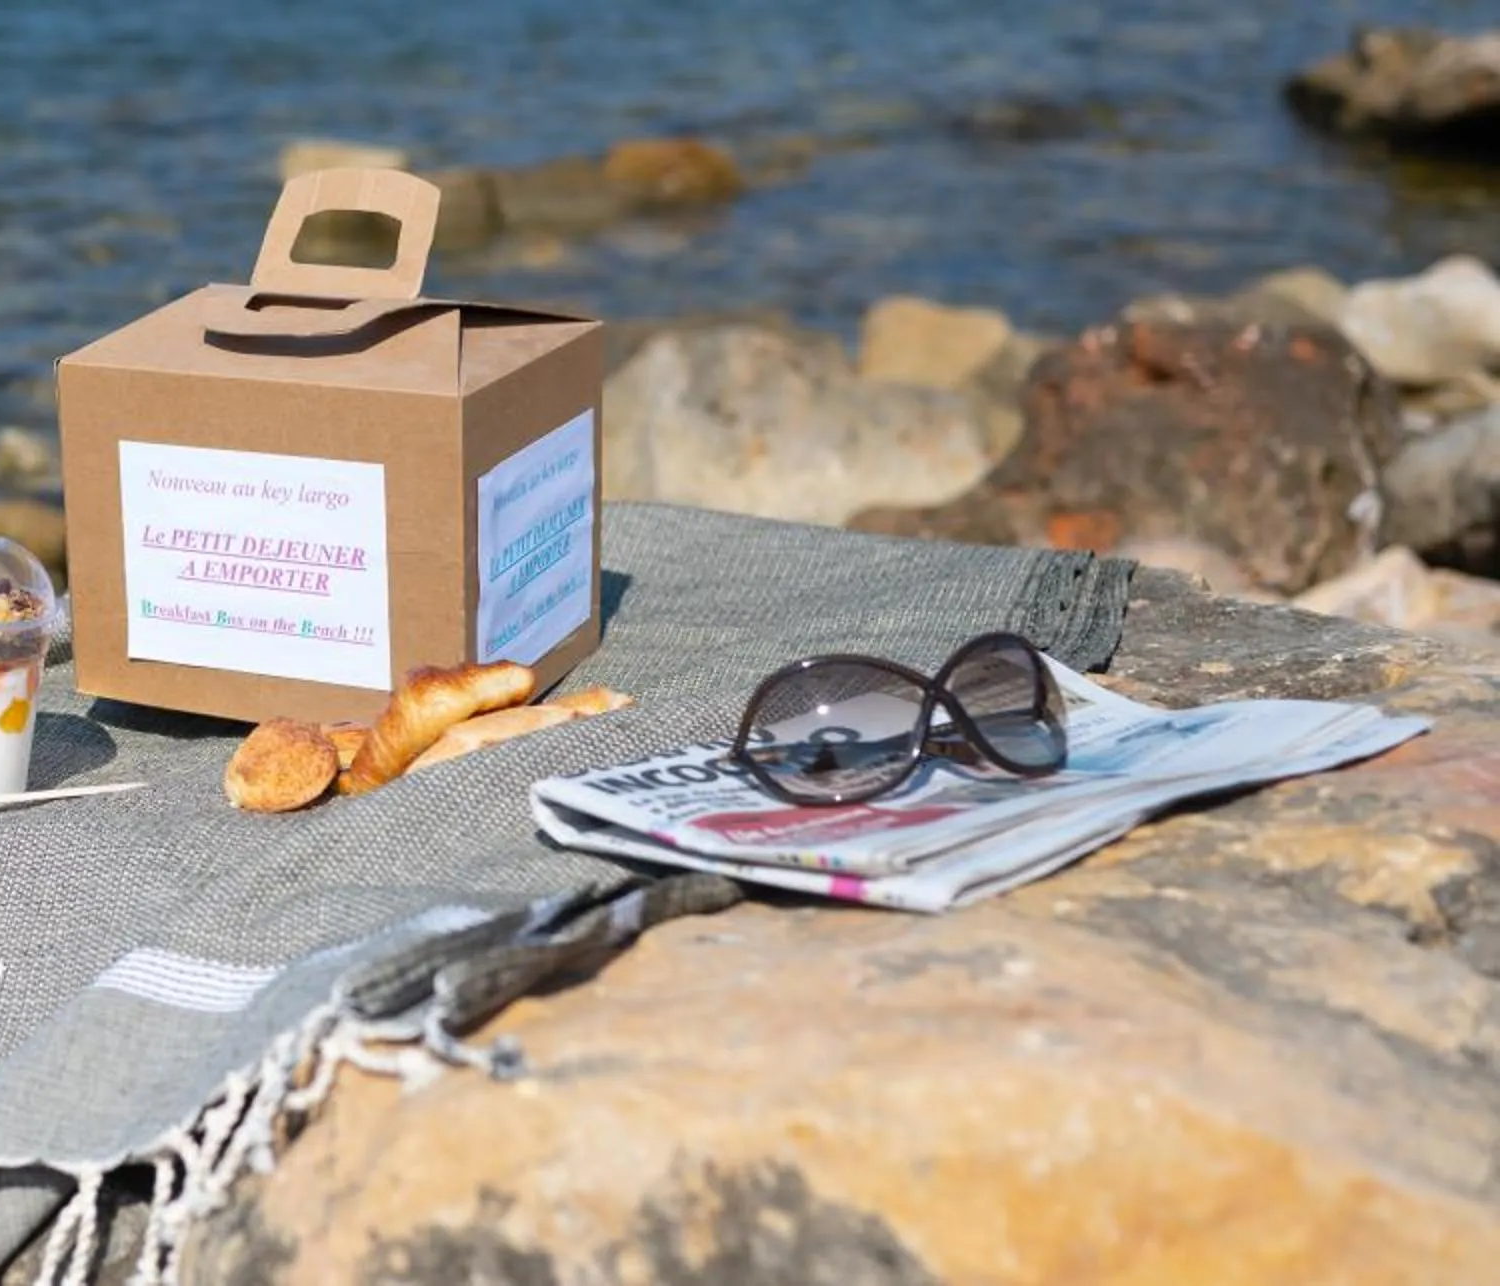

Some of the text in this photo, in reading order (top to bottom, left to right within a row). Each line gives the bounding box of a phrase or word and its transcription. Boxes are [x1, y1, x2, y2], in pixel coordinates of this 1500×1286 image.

[147, 468, 350, 511] Nouveau au key largo
[142, 524, 367, 568] Le PETIT DEJEUNER
[181, 560, 331, 592] A EMPORTER
[141, 599, 213, 624] Breakfast
[215, 610, 245, 626] Box
[249, 617, 268, 631] on
[272, 617, 297, 633] the
[301, 619, 349, 640] Beach
